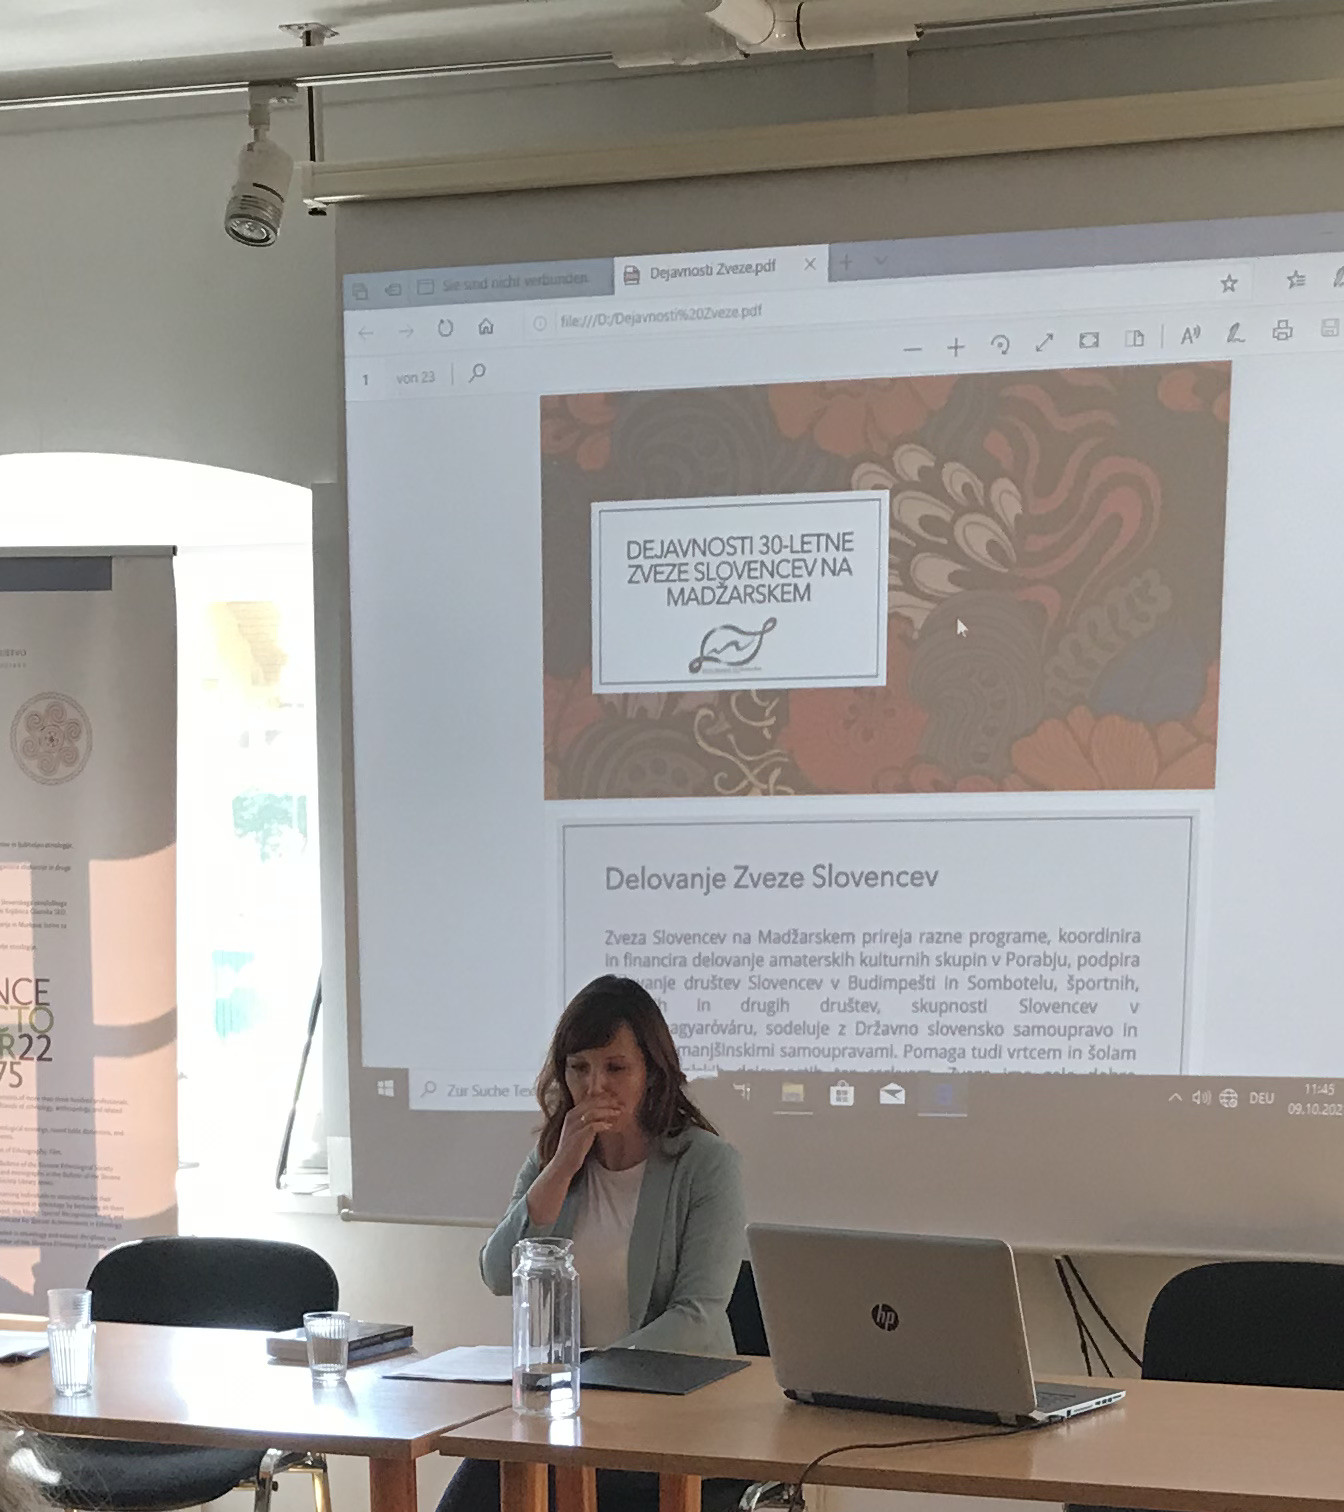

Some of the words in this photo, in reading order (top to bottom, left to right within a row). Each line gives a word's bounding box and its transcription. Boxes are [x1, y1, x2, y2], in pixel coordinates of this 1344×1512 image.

[650, 263, 713, 281] Dejavnosti
[716, 259, 777, 279] Zveze.pdf
[396, 375, 418, 386] von
[420, 371, 436, 384] 23
[626, 535, 754, 561] DEJAVNOSTI
[758, 531, 855, 555] 30-LETNE
[627, 562, 690, 585] ZVEZE
[693, 558, 818, 583] SLOVENCEV
[820, 556, 854, 577] NA
[666, 582, 812, 607] MADŽARSKEM
[605, 865, 727, 896] Delovanje
[733, 864, 805, 889] Zveze
[811, 862, 939, 889] Slovencev
[604, 929, 647, 946] Zveza
[652, 928, 727, 946] Slovencev
[732, 932, 751, 945] na
[758, 927, 856, 945] Madžarskem
[862, 928, 913, 949] prireja
[918, 930, 963, 945] razne
[969, 929, 1052, 949] programe,
[1058, 926, 1142, 945] koordinira
[604, 952, 619, 968] in
[623, 951, 688, 968] financira
[692, 951, 765, 971] delovanje
[768, 951, 855, 968] amaterskih
[859, 951, 930, 968] kulturnih
[935, 952, 987, 971] skupin
[991, 955, 1002, 968] v
[1005, 950, 1072, 971] Porabju,
[1076, 950, 1141, 971] podpira
[683, 974, 741, 991] društev
[747, 973, 824, 991] Slovencev
[830, 978, 841, 991] v
[847, 973, 936, 994] Budimpešti
[944, 974, 960, 991] in
[967, 973, 1059, 993] Sombotelu,
[1066, 973, 1140, 994] športnih,
[696, 997, 712, 1013] in
[740, 997, 790, 1017] drugih
[819, 996, 881, 1015] društev,
[911, 997, 988, 1018] skupnosti
[1018, 997, 1099, 1014] Slovencev
[1129, 1001, 1140, 1014] v
[765, 1020, 831, 1040] sodeluje
[837, 1024, 847, 1037] z
[854, 1019, 919, 1037] Državno
[926, 1020, 1005, 1037] slovensko
[1012, 1023, 1114, 1041] samoupravo
[1122, 1021, 1138, 1038] in
[779, 1042, 899, 1062] samoupravami.
[903, 1043, 967, 1063] Pomaga
[971, 1043, 1003, 1060] tudi
[1006, 1044, 1063, 1060] vrtcem
[1067, 1044, 1082, 1060] in
[1087, 1043, 1137, 1061] šolam
[447, 1084, 469, 1097] Zur
[472, 1084, 510, 1098] Suche
[1249, 1091, 1275, 1105] DEU
[1305, 1082, 1336, 1095] 11:45
[876, 1303, 896, 1331] hp
